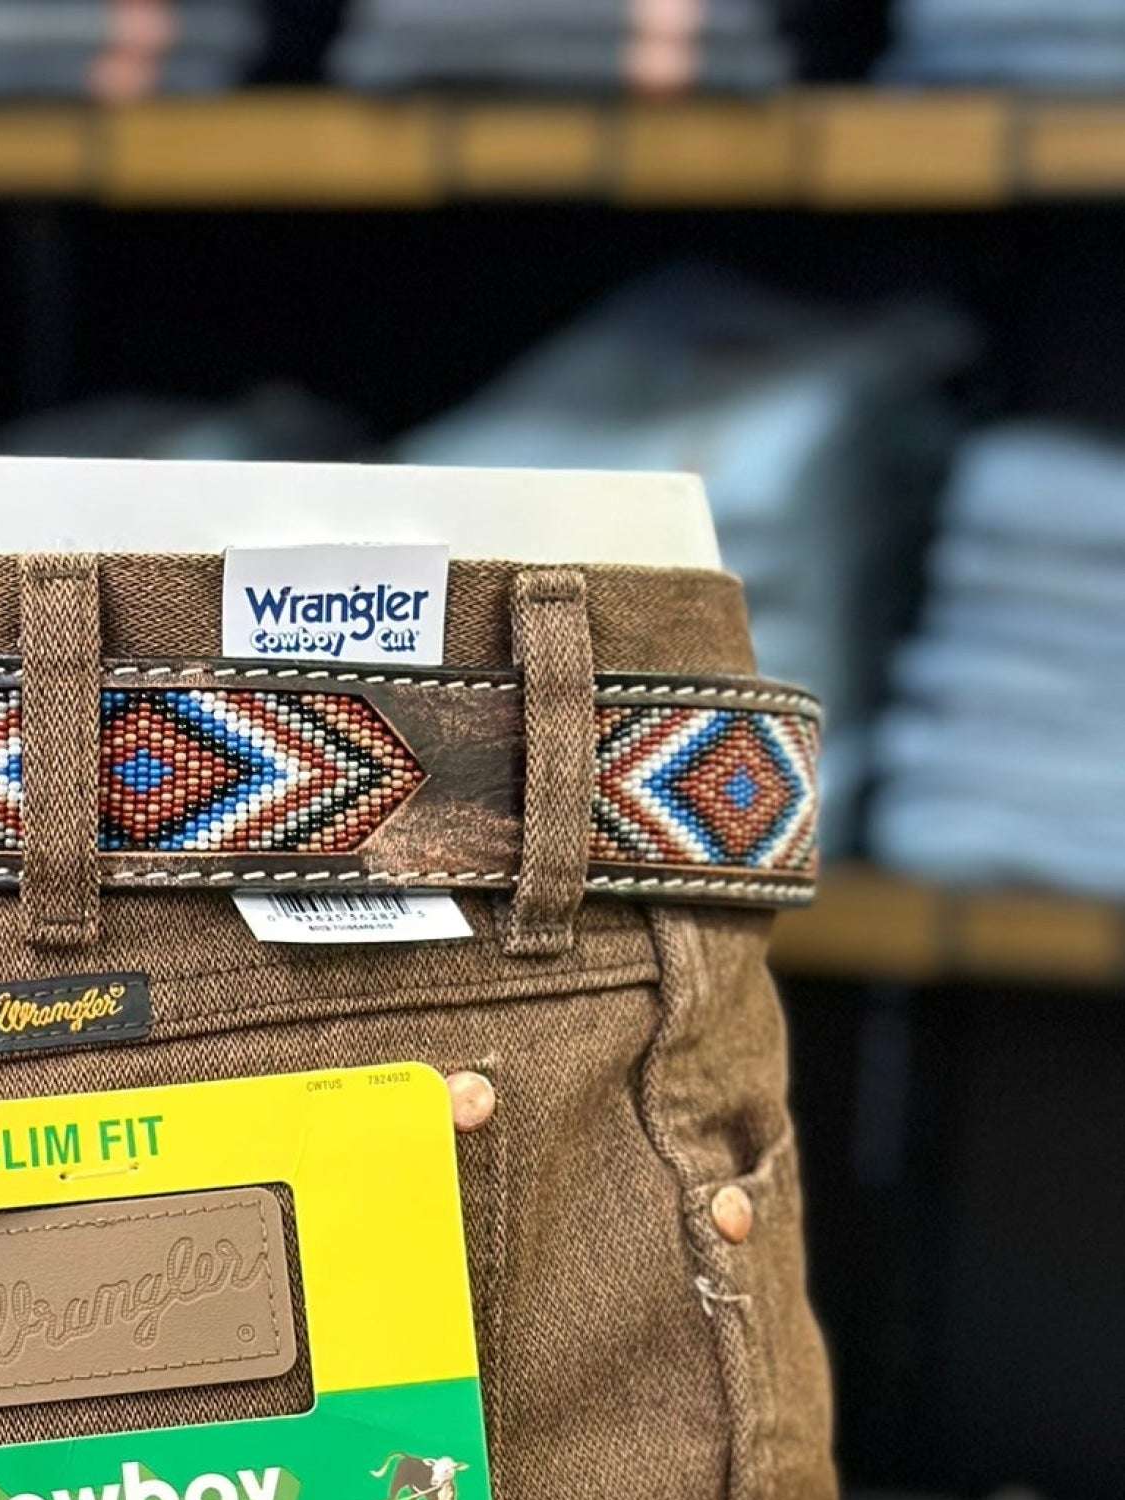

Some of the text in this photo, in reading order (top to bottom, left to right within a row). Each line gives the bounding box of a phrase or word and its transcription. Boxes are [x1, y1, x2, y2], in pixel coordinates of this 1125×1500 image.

[244, 584, 430, 641] Wrangler
[251, 627, 418, 657] Cowboy Cut
[100, 1115, 165, 1162] FIT
